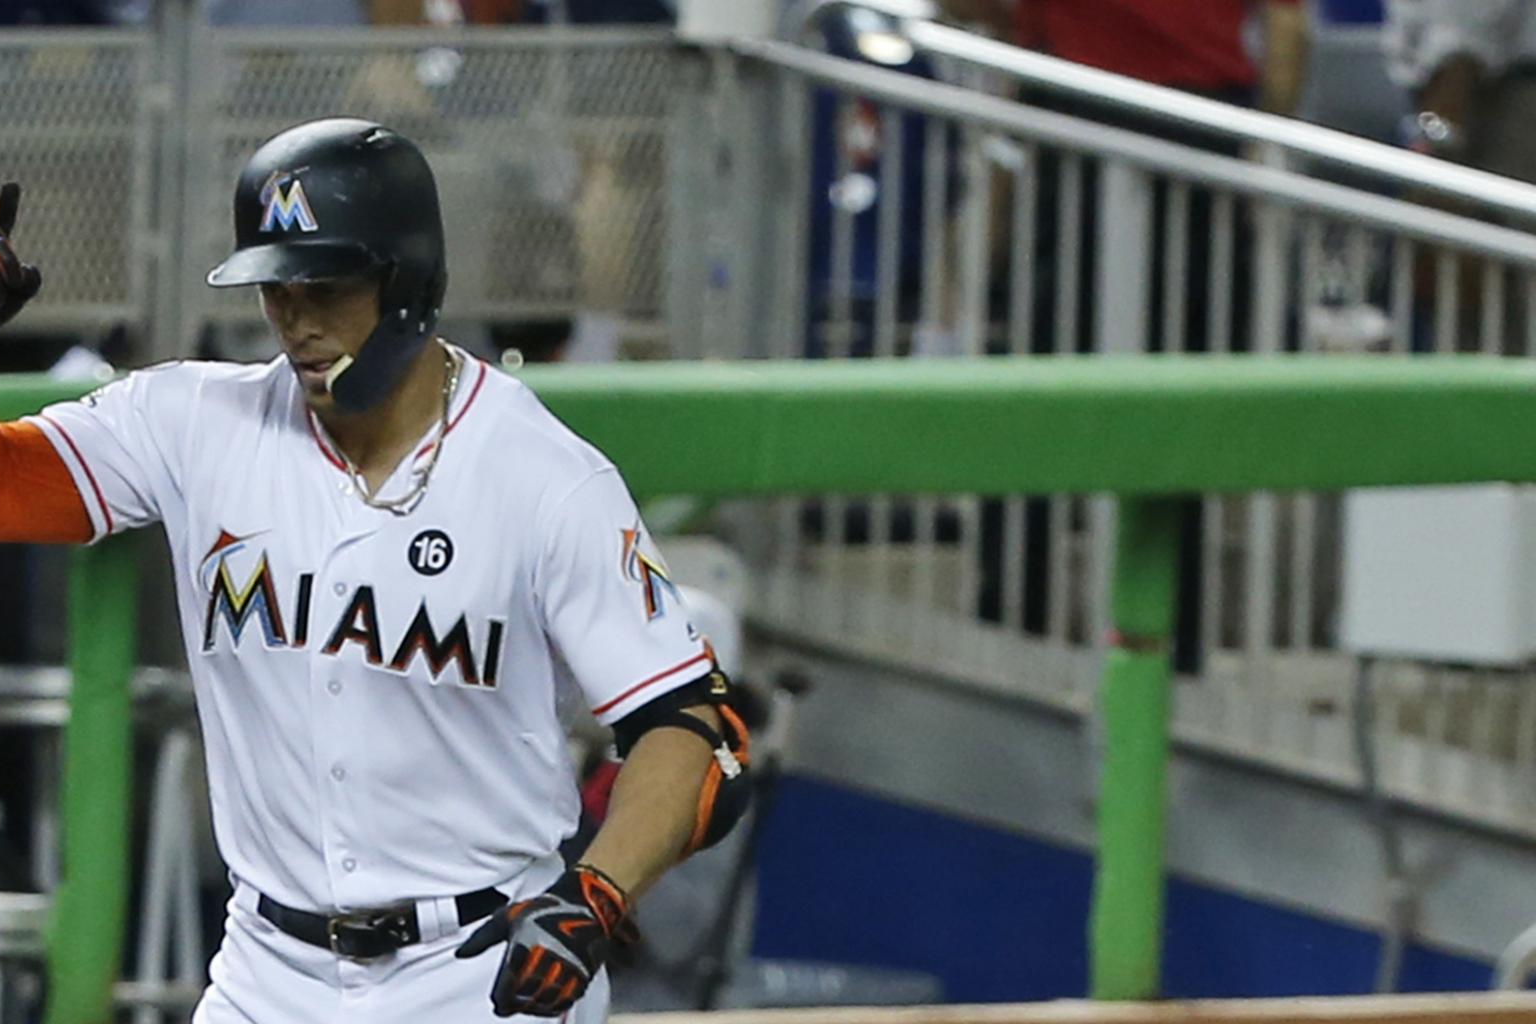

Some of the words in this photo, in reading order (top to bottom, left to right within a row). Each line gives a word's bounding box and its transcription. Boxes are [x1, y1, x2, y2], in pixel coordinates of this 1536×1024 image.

[259, 177, 319, 233] M
[414, 536, 448, 569] 16
[201, 545, 506, 690] MIAMI
